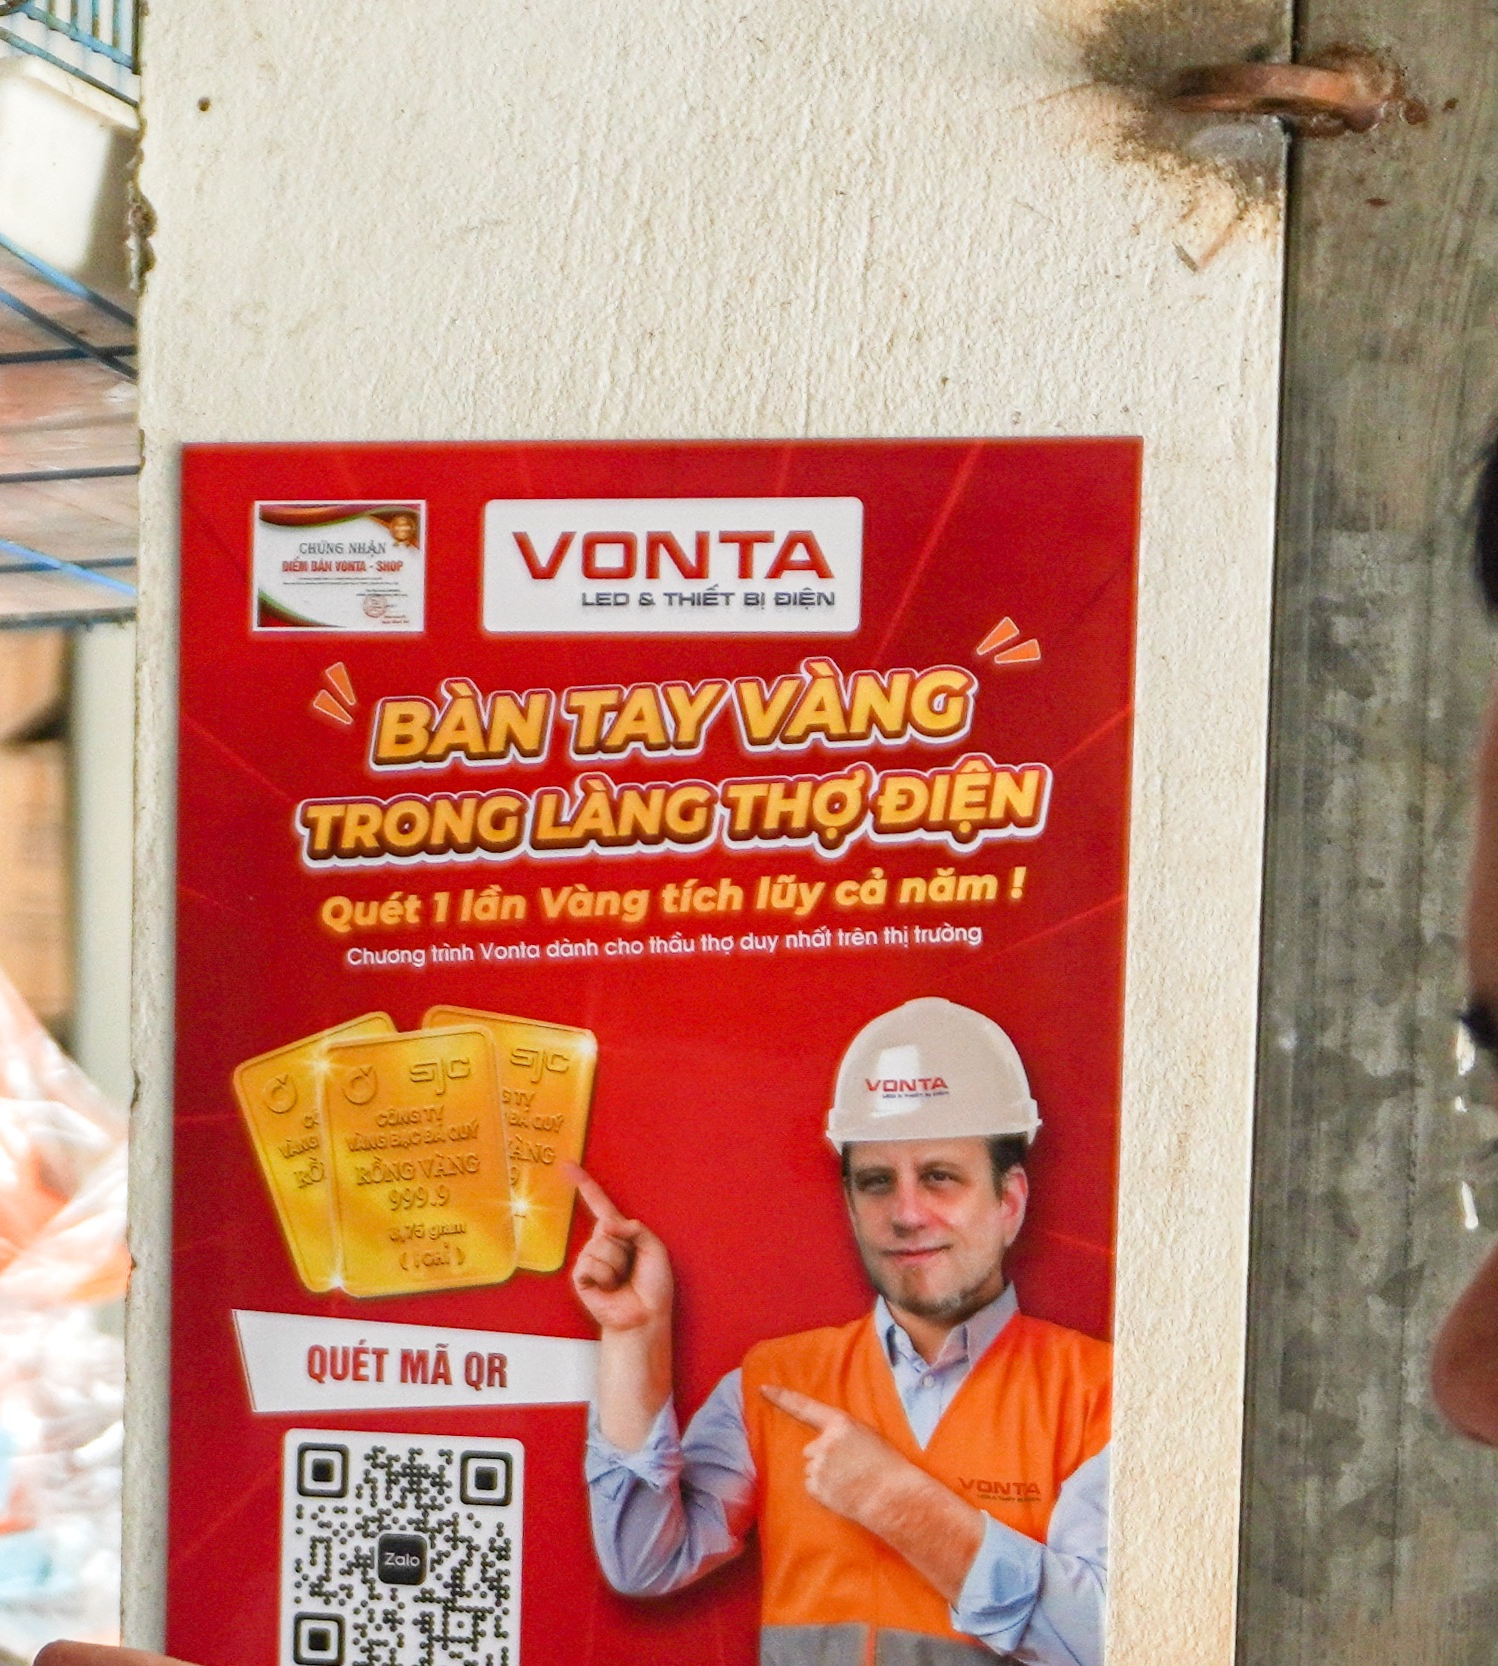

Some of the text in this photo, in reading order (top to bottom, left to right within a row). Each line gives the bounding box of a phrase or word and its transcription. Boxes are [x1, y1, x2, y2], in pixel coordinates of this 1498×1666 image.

[335, 561, 367, 573] VONTA
[376, 561, 404, 573] SHOP
[512, 530, 835, 580] VONTA
[582, 584, 835, 610] LED & THIẾT BỊ ĐIỆN
[373, 658, 974, 766] BÀN TAY VÀNG
[303, 756, 1045, 863] TRONG LÀNG THỢ ĐIỆN
[321, 866, 1027, 932] Quét 1 lần Vàng tích lũy cả năm !
[347, 923, 983, 967] Chương trình Vonta dành cho thầu thợ duy nhất trên thị trường
[409, 1059, 470, 1096] SJC
[509, 1047, 570, 1084] SJC
[865, 1077, 949, 1092] VONTA
[375, 1105, 445, 1128] CÔNG TY
[355, 1156, 415, 1186] RỒNG
[417, 1153, 481, 1179] VÀNG
[389, 1185, 450, 1212] 999.9
[308, 1339, 508, 1391] QUÉT MÃ QR
[958, 1477, 1041, 1495] VONTA
[384, 1552, 421, 1567] Zalo
